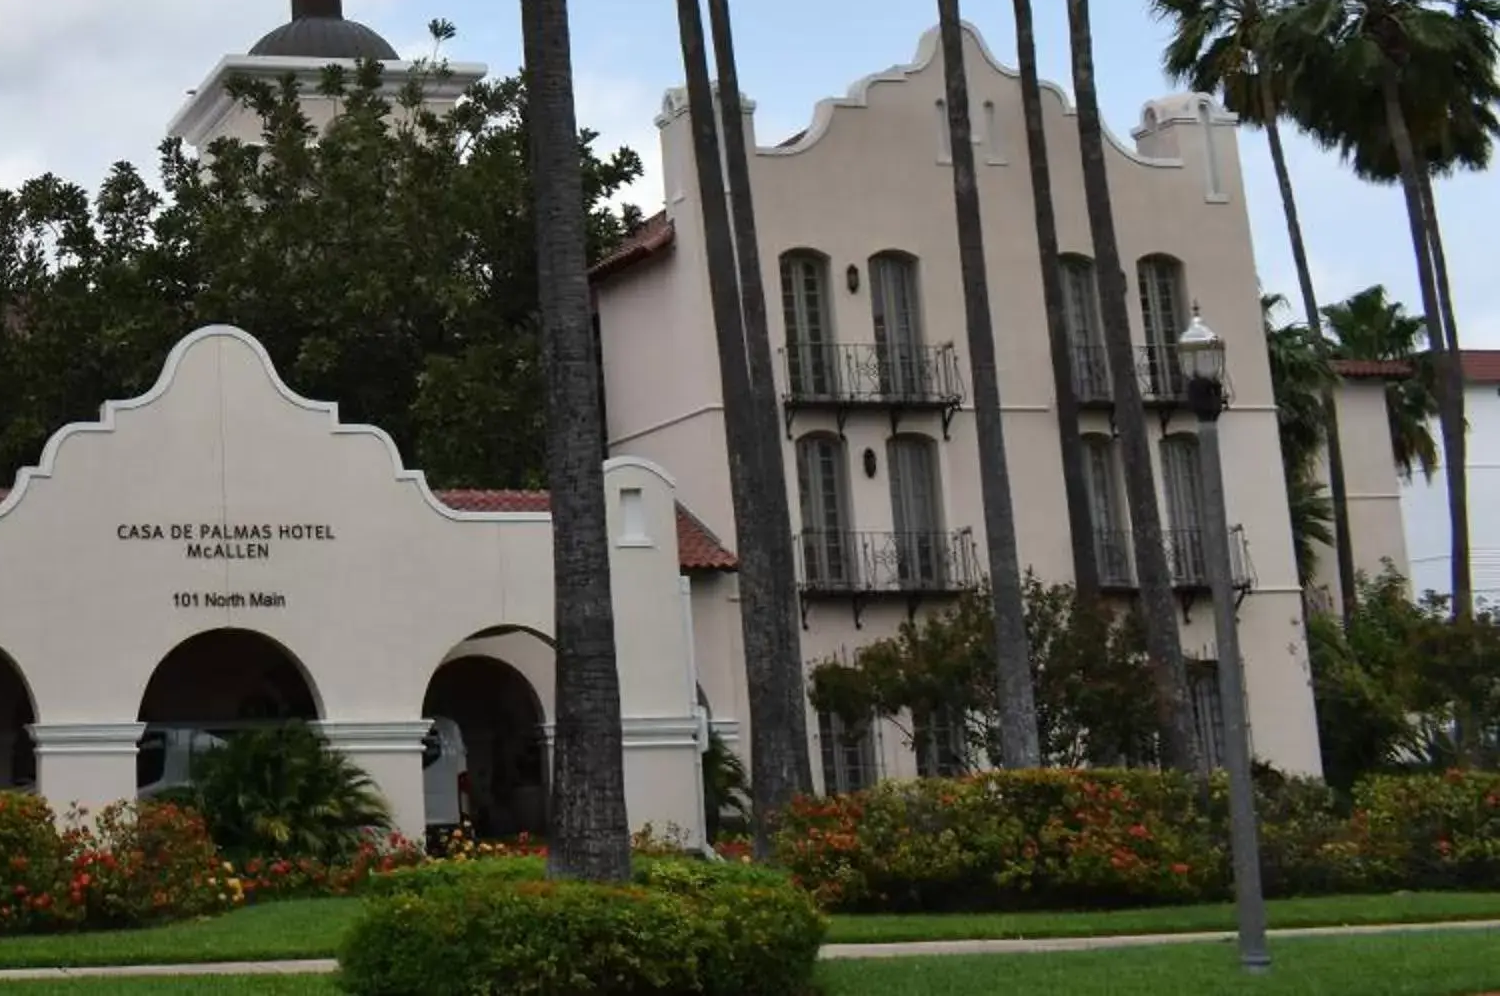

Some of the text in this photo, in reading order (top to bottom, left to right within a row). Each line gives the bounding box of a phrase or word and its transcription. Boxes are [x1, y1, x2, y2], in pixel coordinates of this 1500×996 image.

[117, 524, 335, 539] CASA DE PALMAS HOTEL
[187, 544, 269, 558] McALLEN
[173, 592, 286, 607] 101 North Main
